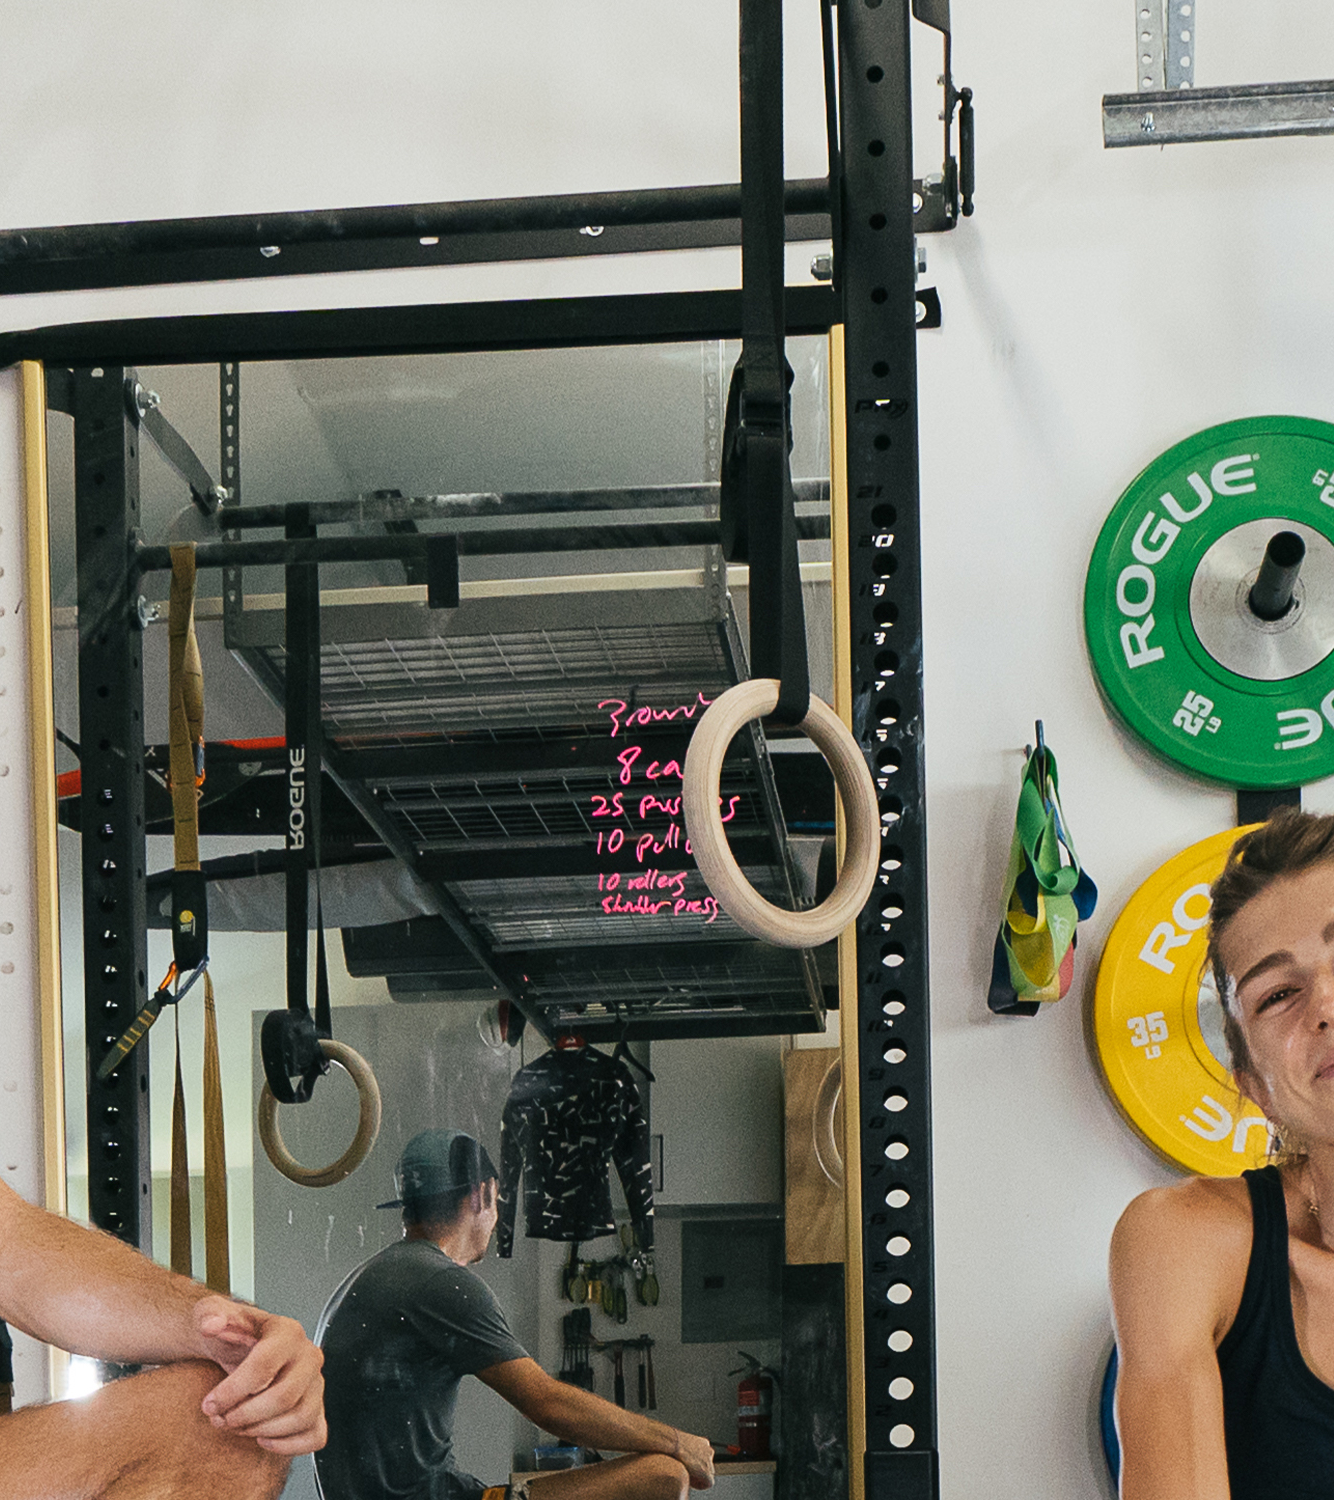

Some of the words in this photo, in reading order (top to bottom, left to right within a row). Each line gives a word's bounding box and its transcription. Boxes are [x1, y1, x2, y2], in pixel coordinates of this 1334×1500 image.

[1116, 453, 1258, 669] ROGUE
[1172, 690, 1215, 737] 25
[617, 746, 642, 785] 8
[597, 828, 624, 855] 10
[598, 872, 621, 892] 10
[1127, 1010, 1168, 1048] 35
[1145, 1045, 1162, 1060] LB
[869, 1164, 884, 1177] 7
[871, 1260, 888, 1273] 5
